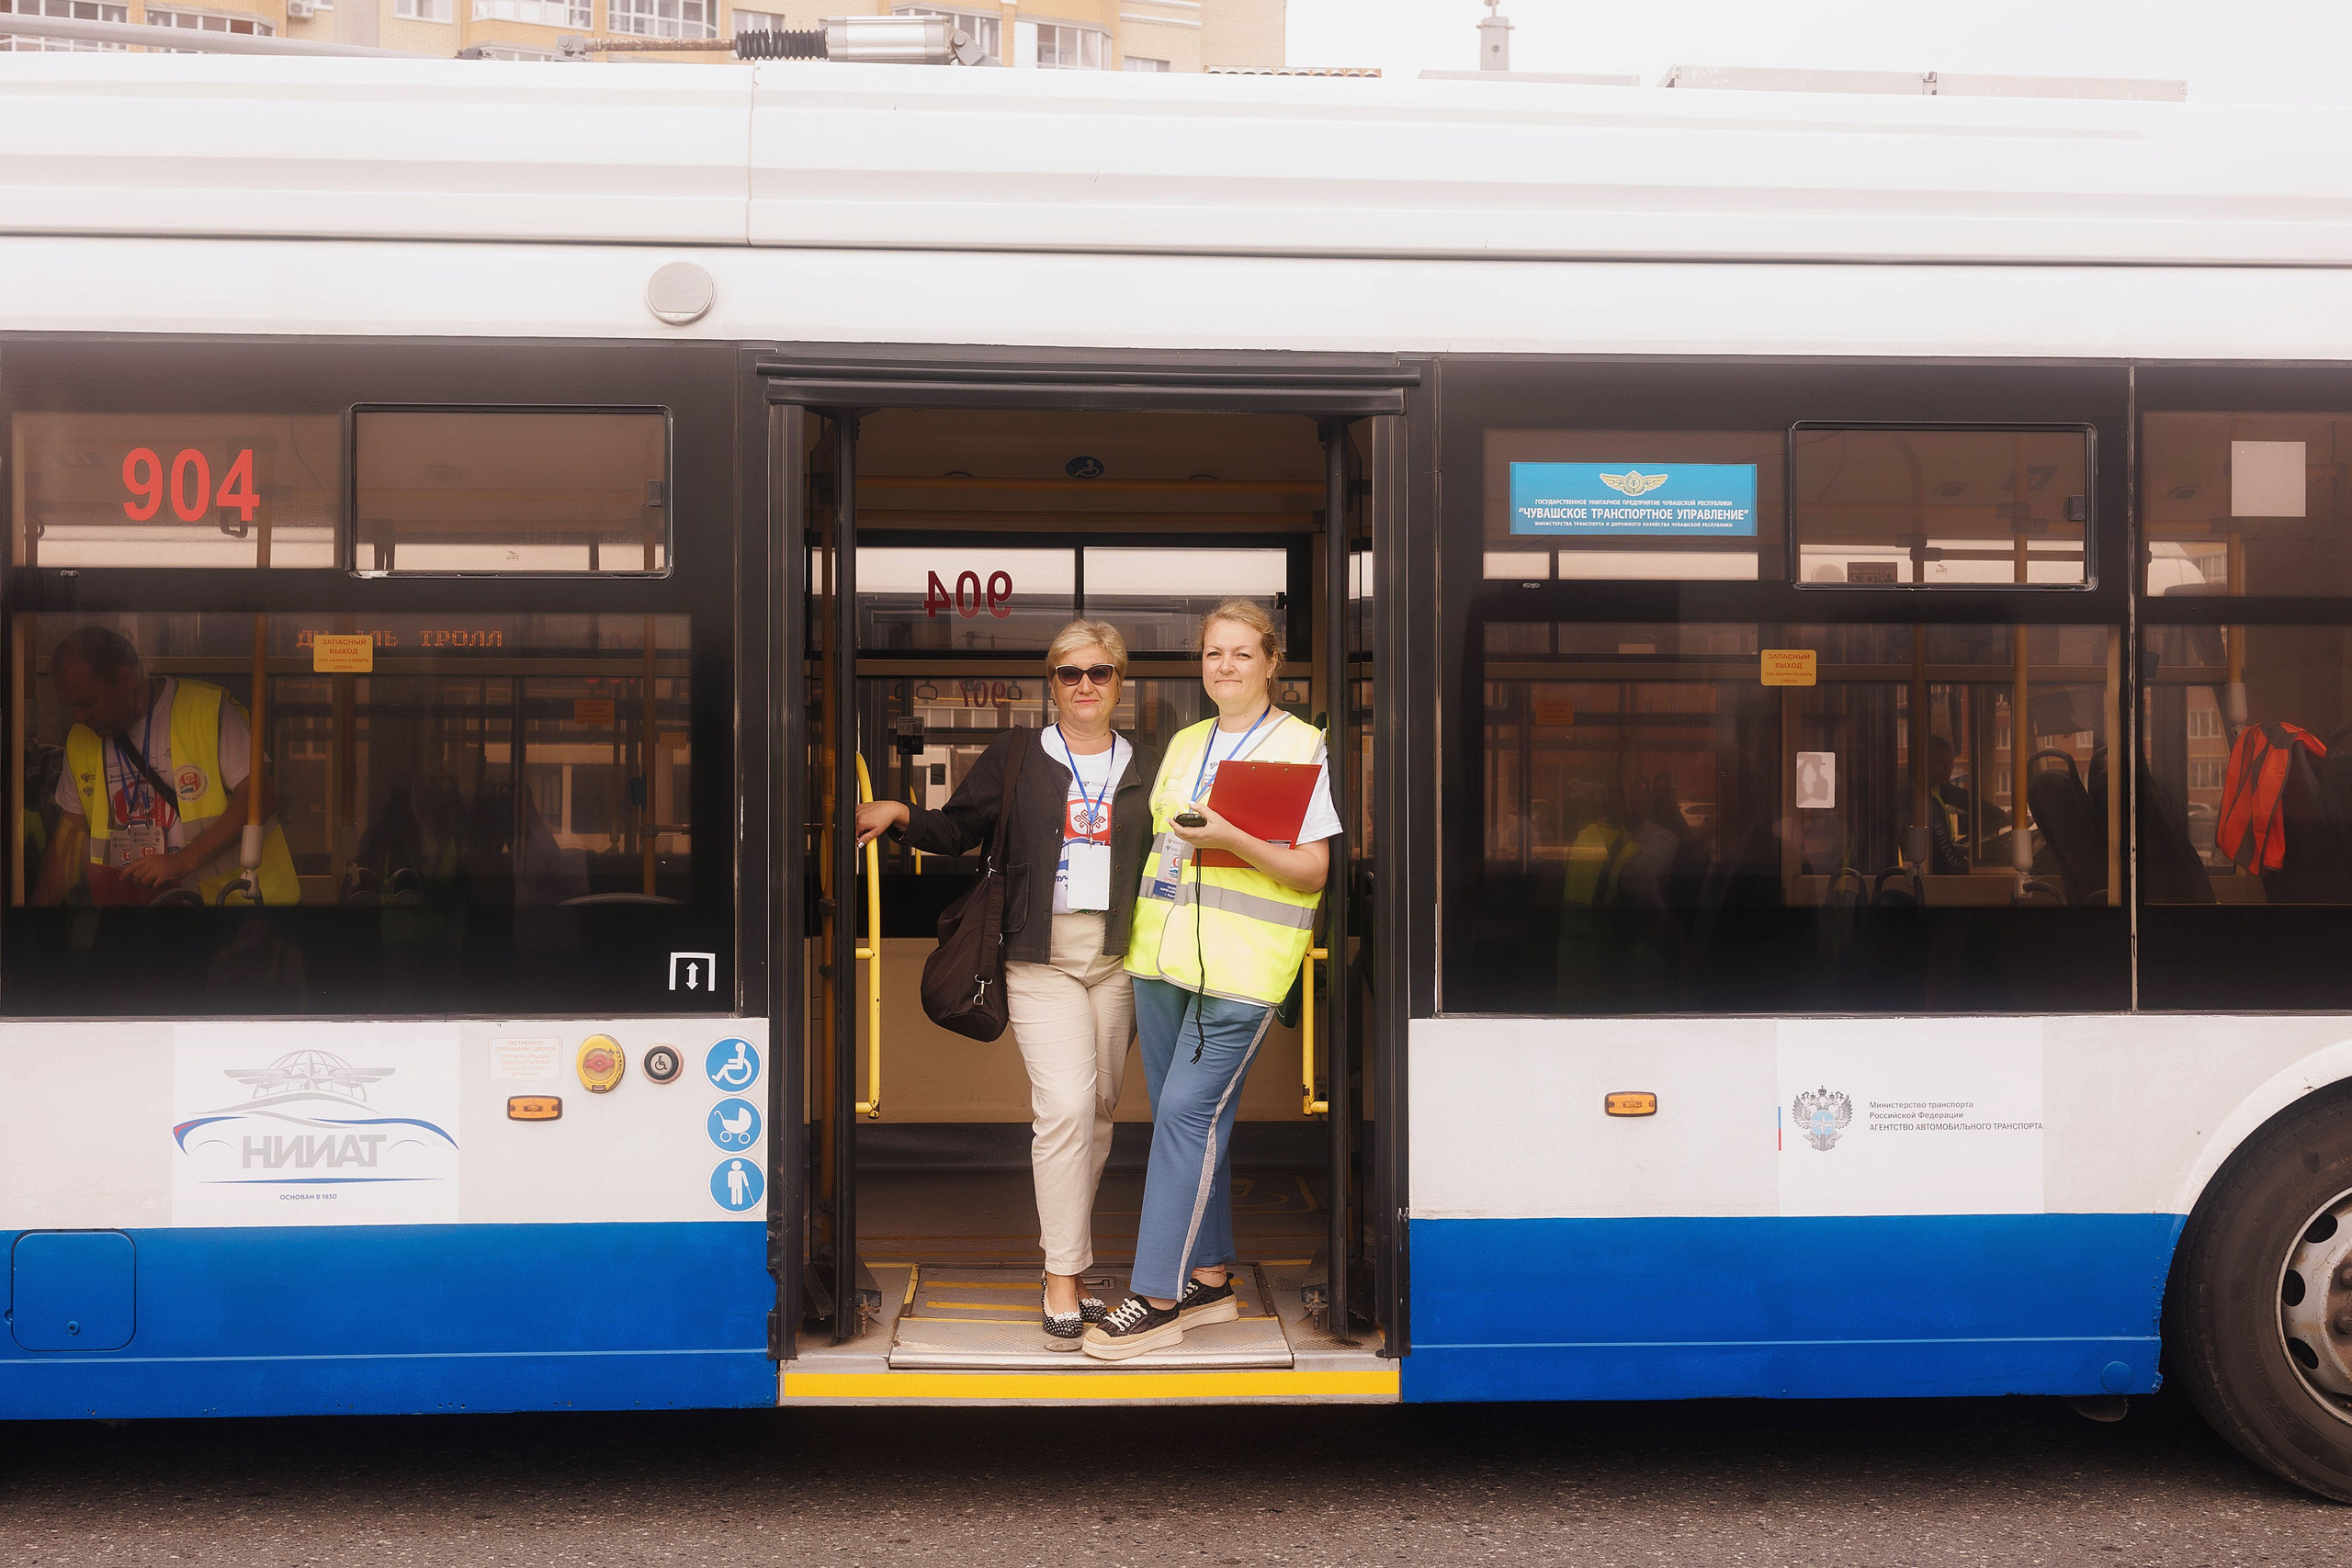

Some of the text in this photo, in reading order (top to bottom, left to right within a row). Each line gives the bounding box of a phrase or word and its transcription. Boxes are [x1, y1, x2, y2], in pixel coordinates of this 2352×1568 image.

[122, 447, 260, 522] 904
[1591, 508, 1673, 520] ТРАНСПОРТНОЕ
[322, 637, 367, 646] ЗАПАСНЫЙ
[419, 630, 503, 647] ТРОЛЛ
[329, 648, 358, 656] ВЫХОД
[1917, 1111, 1963, 1120] Федерации
[243, 1134, 387, 1168] НИИАТ
